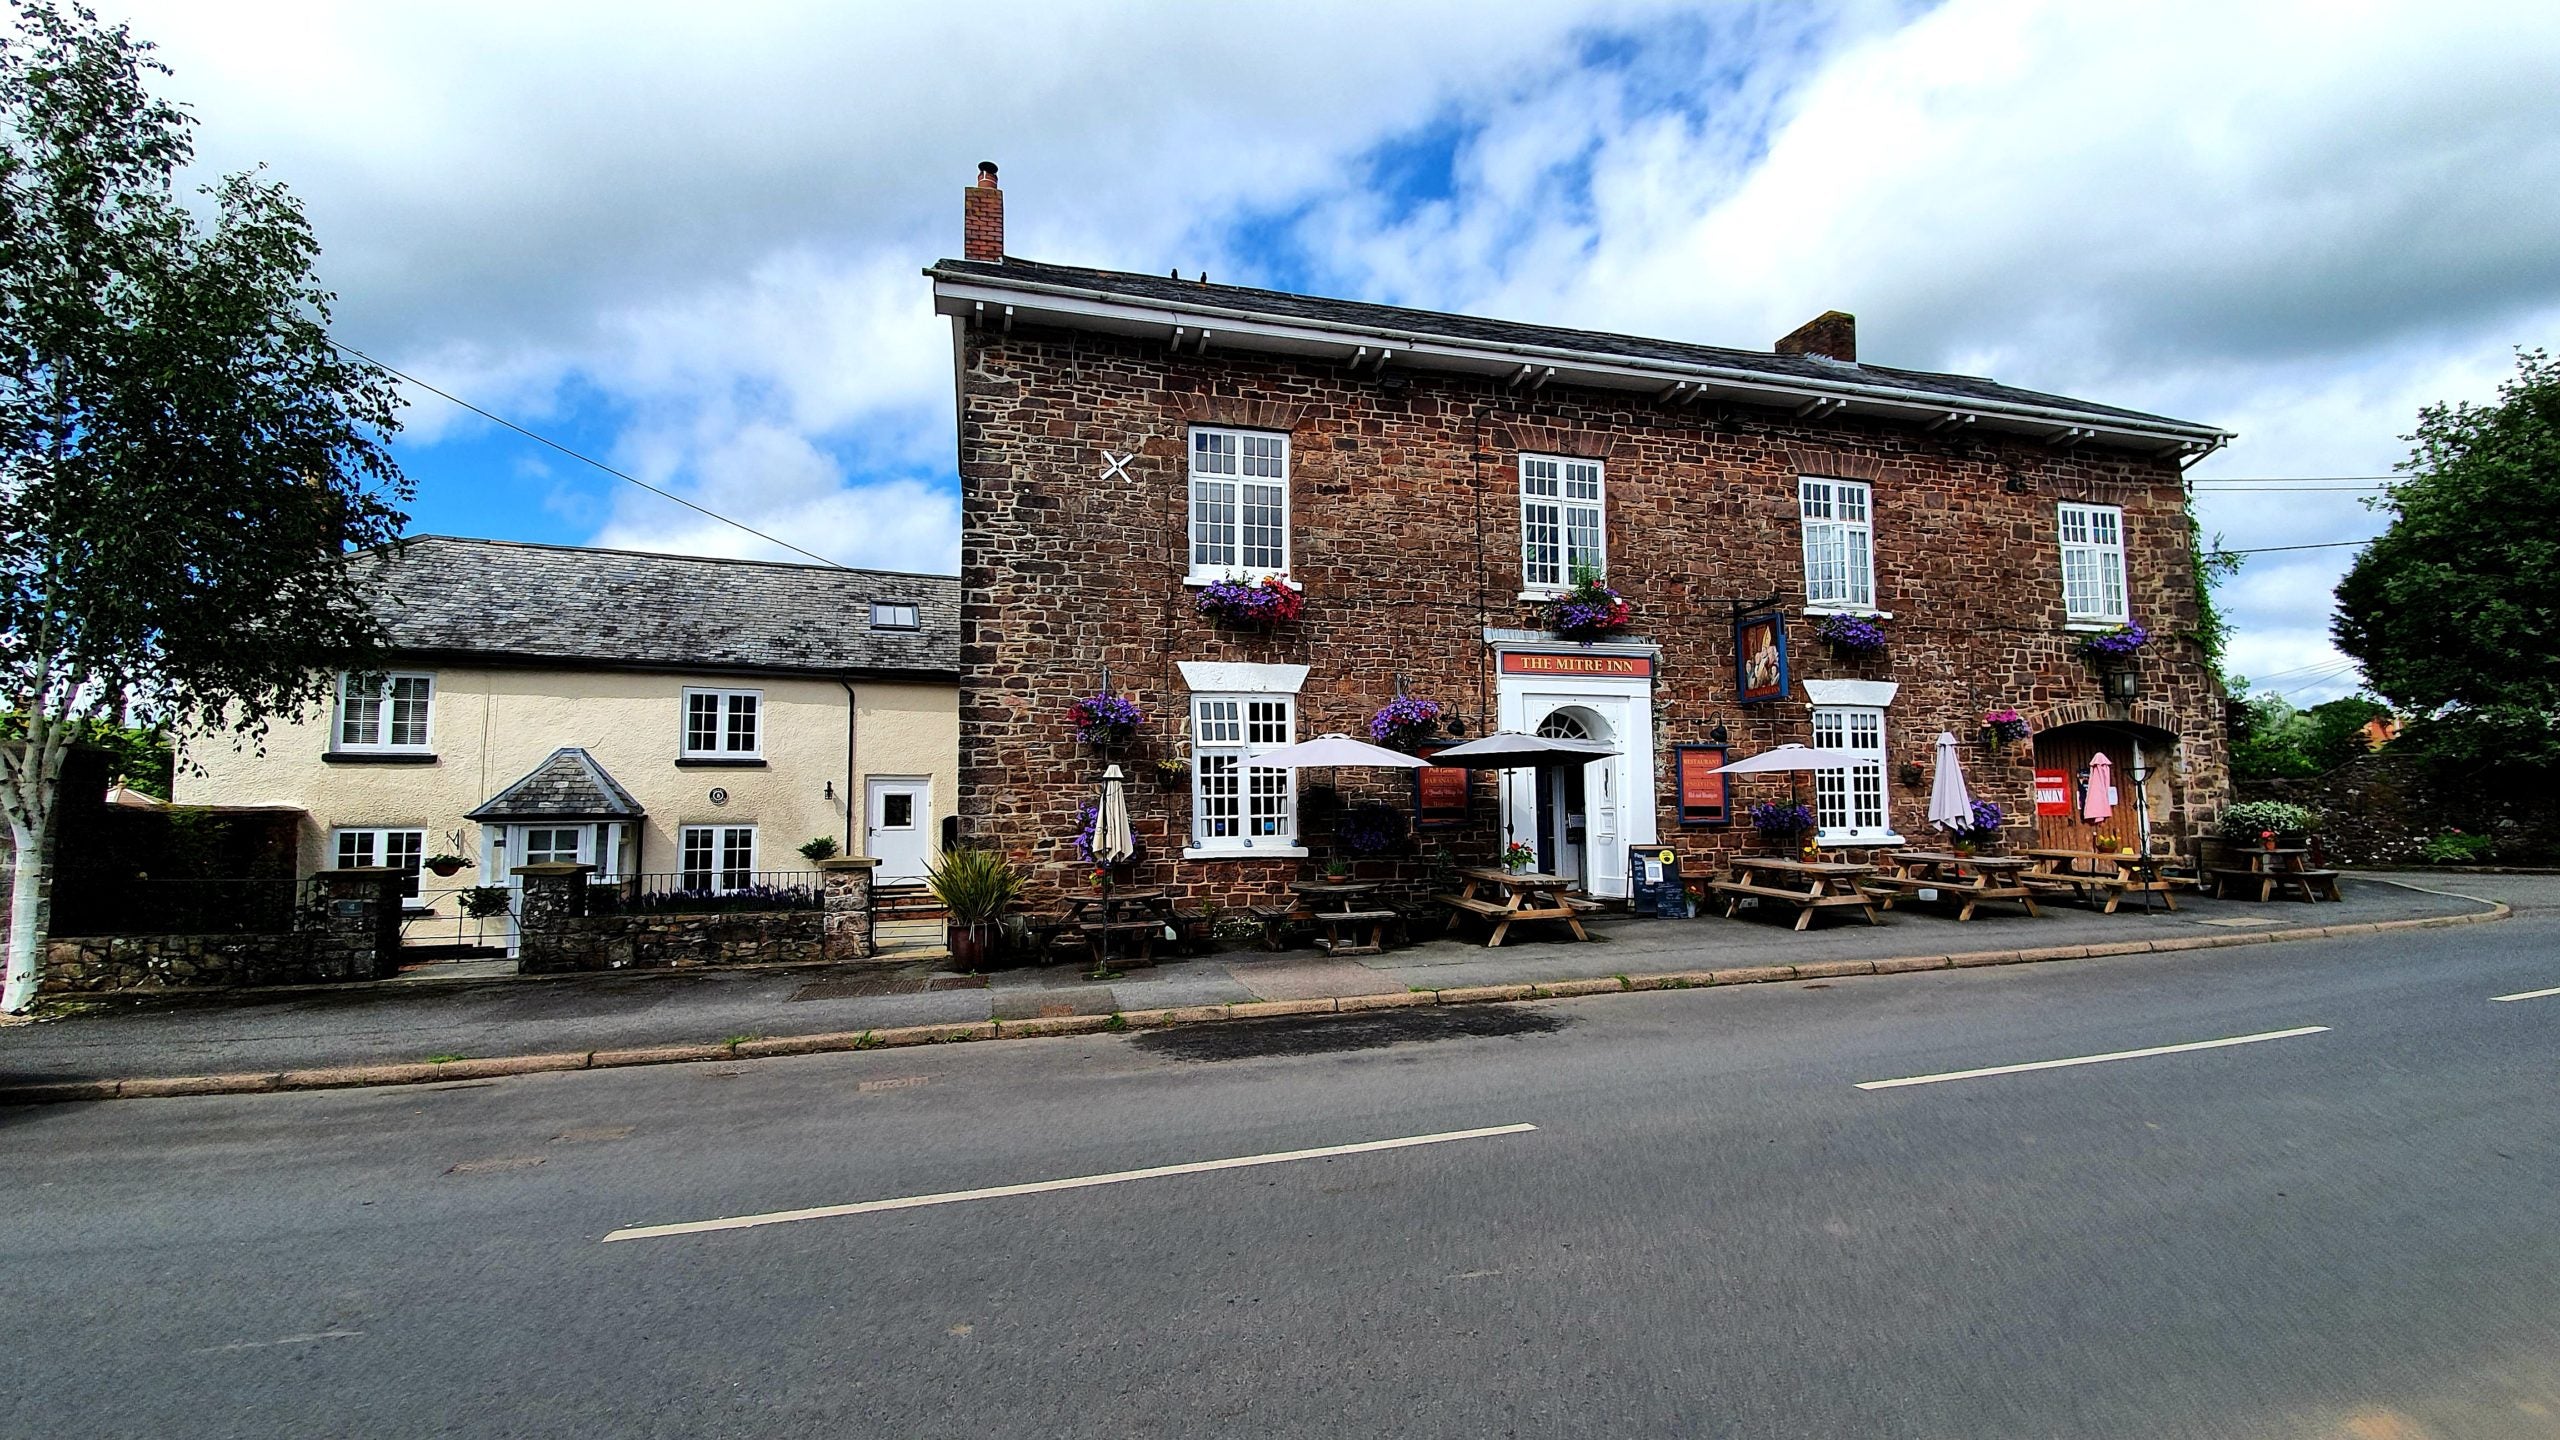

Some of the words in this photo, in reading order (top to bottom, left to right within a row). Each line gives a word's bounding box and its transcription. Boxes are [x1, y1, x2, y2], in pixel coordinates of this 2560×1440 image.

[1520, 657, 1552, 670] THE
[1556, 658, 1603, 671] MITRE
[1607, 660, 1633, 672] INN
[2036, 788, 2064, 803] AWAY
